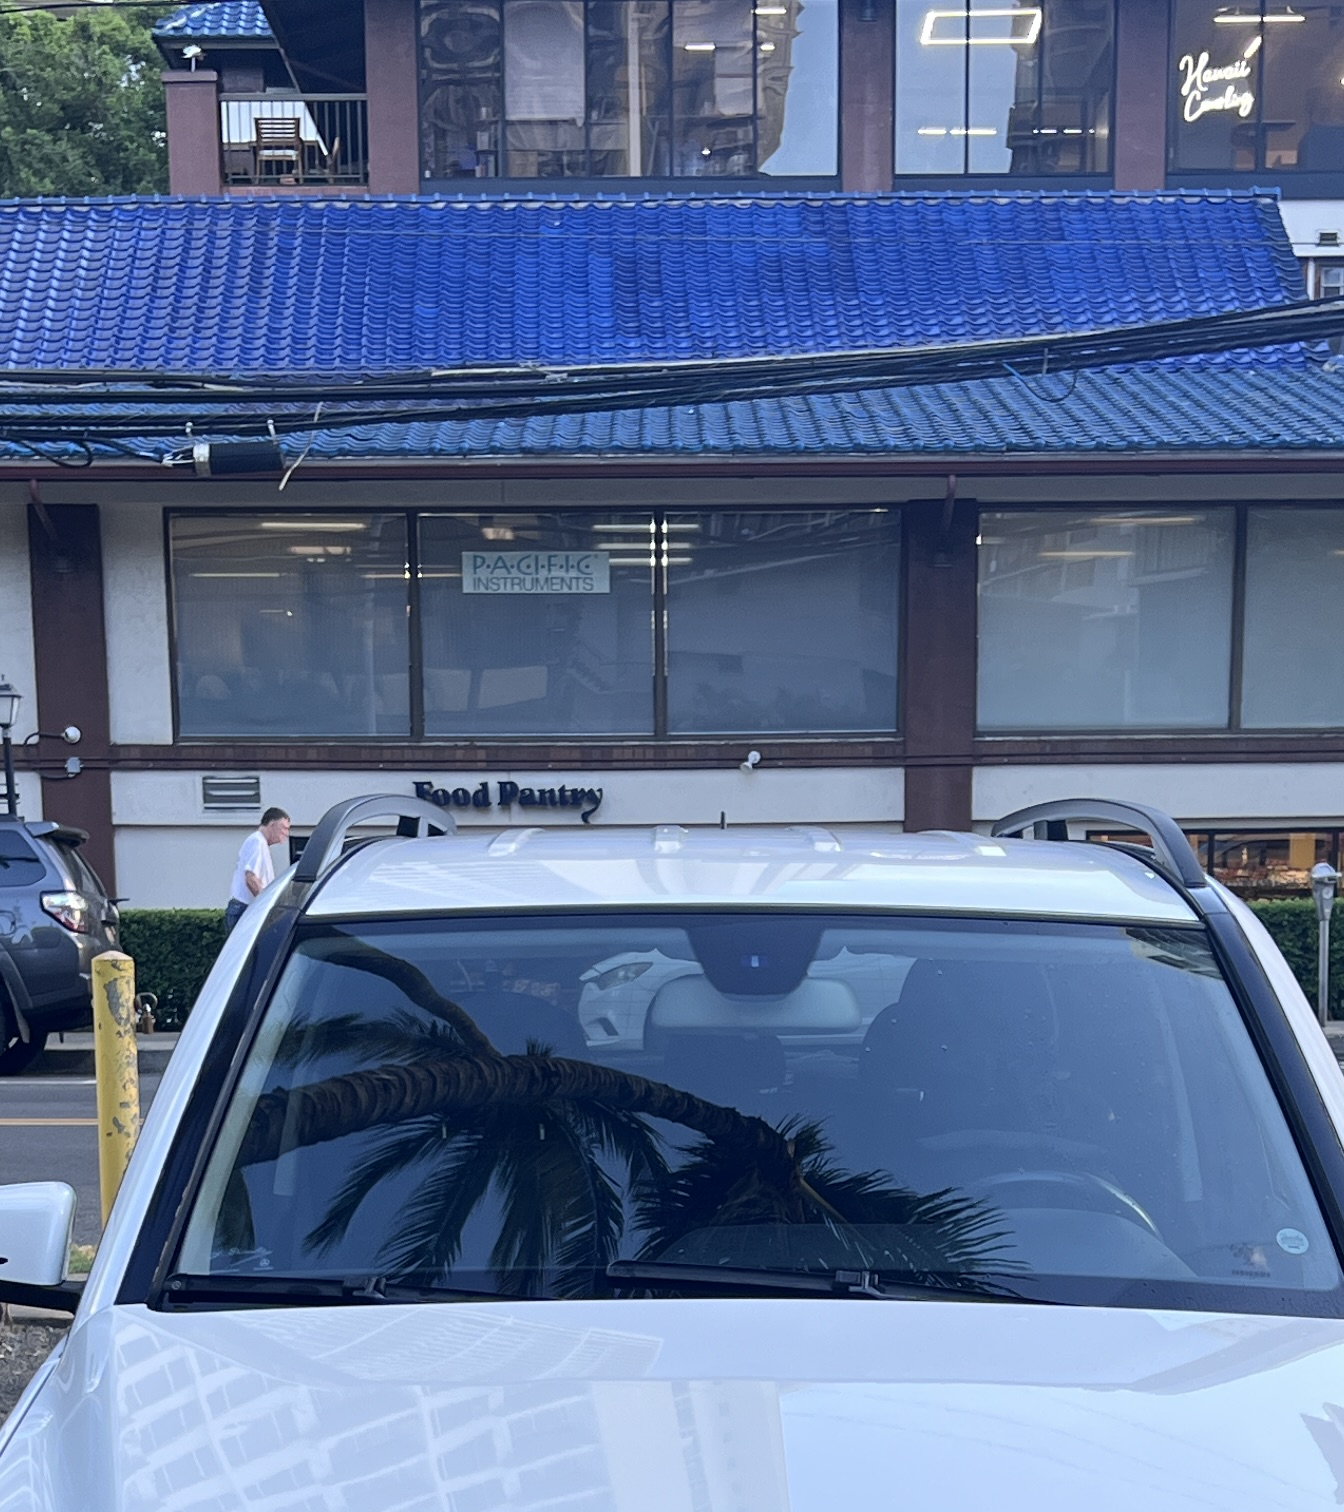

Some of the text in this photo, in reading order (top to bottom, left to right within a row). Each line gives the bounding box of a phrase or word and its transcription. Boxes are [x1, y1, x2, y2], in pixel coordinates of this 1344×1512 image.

[472, 576, 594, 592] INSTRUMENTS
[412, 780, 603, 824] Food Pantry
